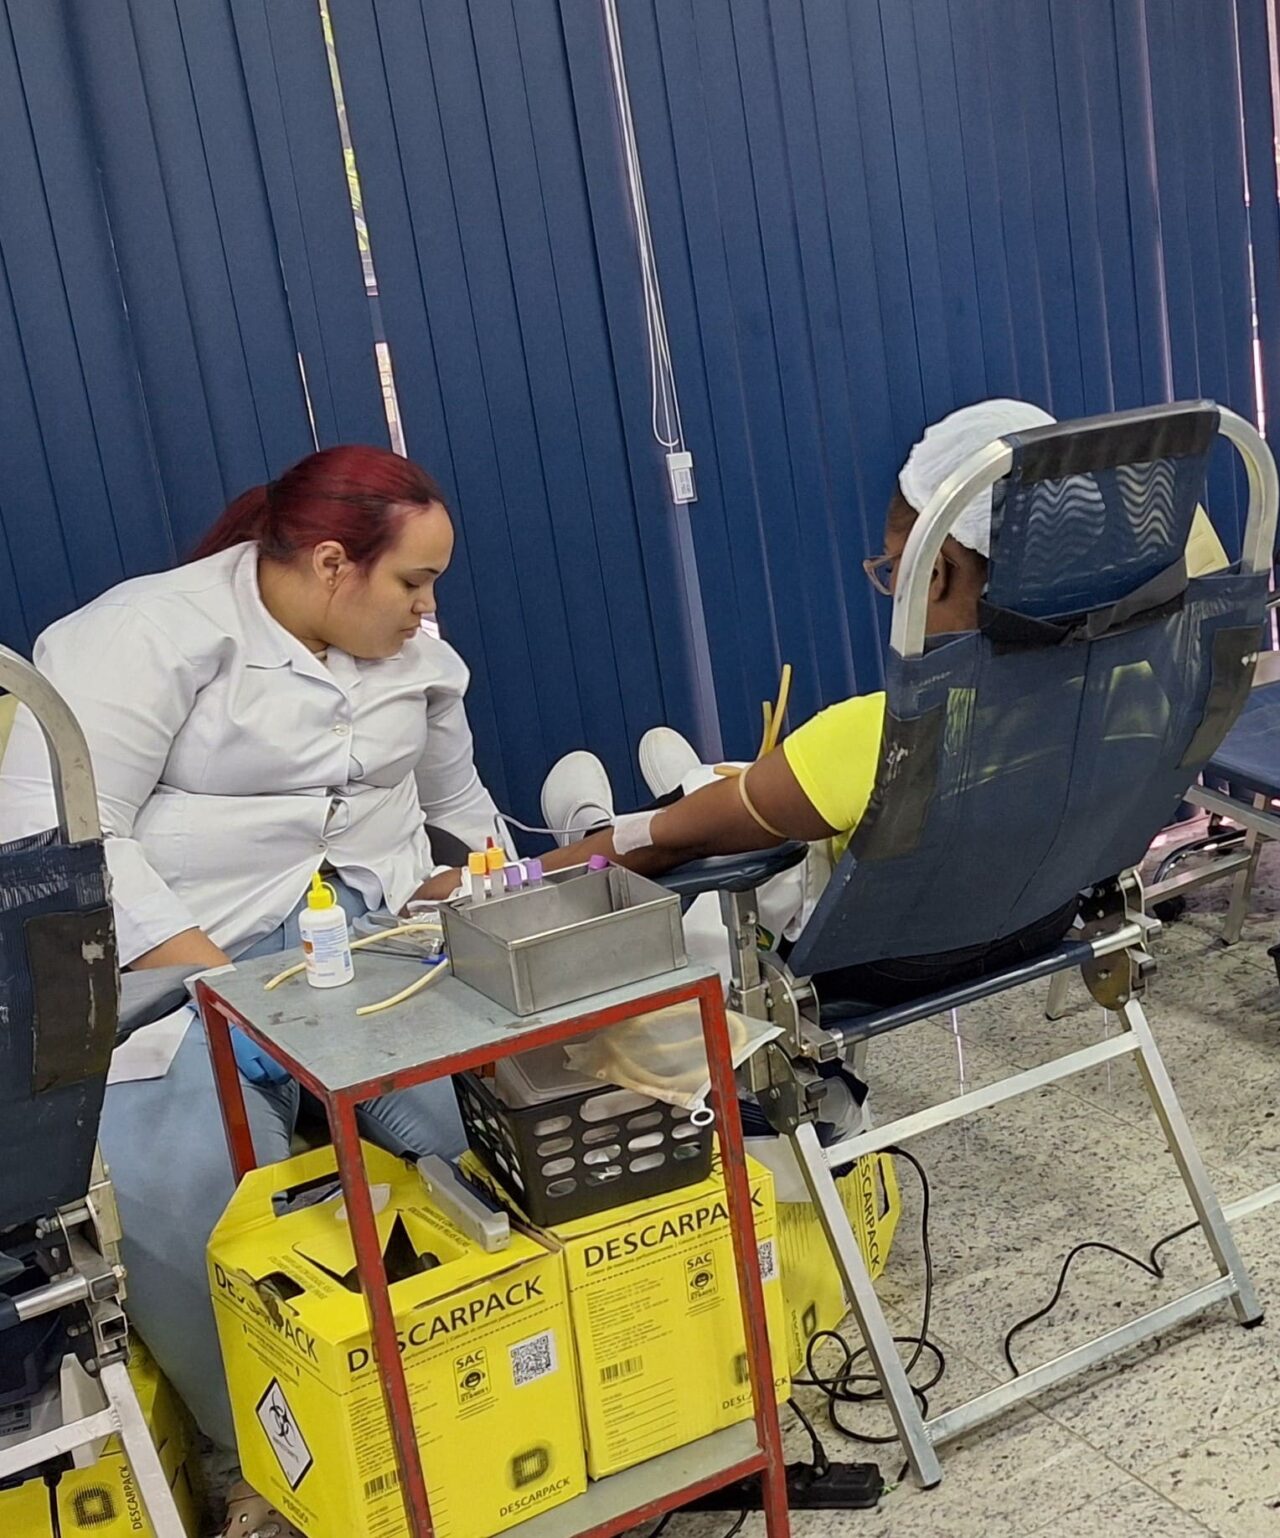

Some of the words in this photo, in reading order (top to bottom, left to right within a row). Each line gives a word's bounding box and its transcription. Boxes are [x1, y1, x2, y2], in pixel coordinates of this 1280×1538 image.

[584, 1187, 764, 1269] DESCARPAK
[860, 1153, 881, 1272] ESCARPACK
[687, 1251, 713, 1270] SAC
[347, 1274, 544, 1373] DSCARPACK
[456, 1349, 485, 1370] SAC
[119, 1465, 144, 1531] DESCARPACK
[499, 1476, 572, 1518] DESCARPACK
